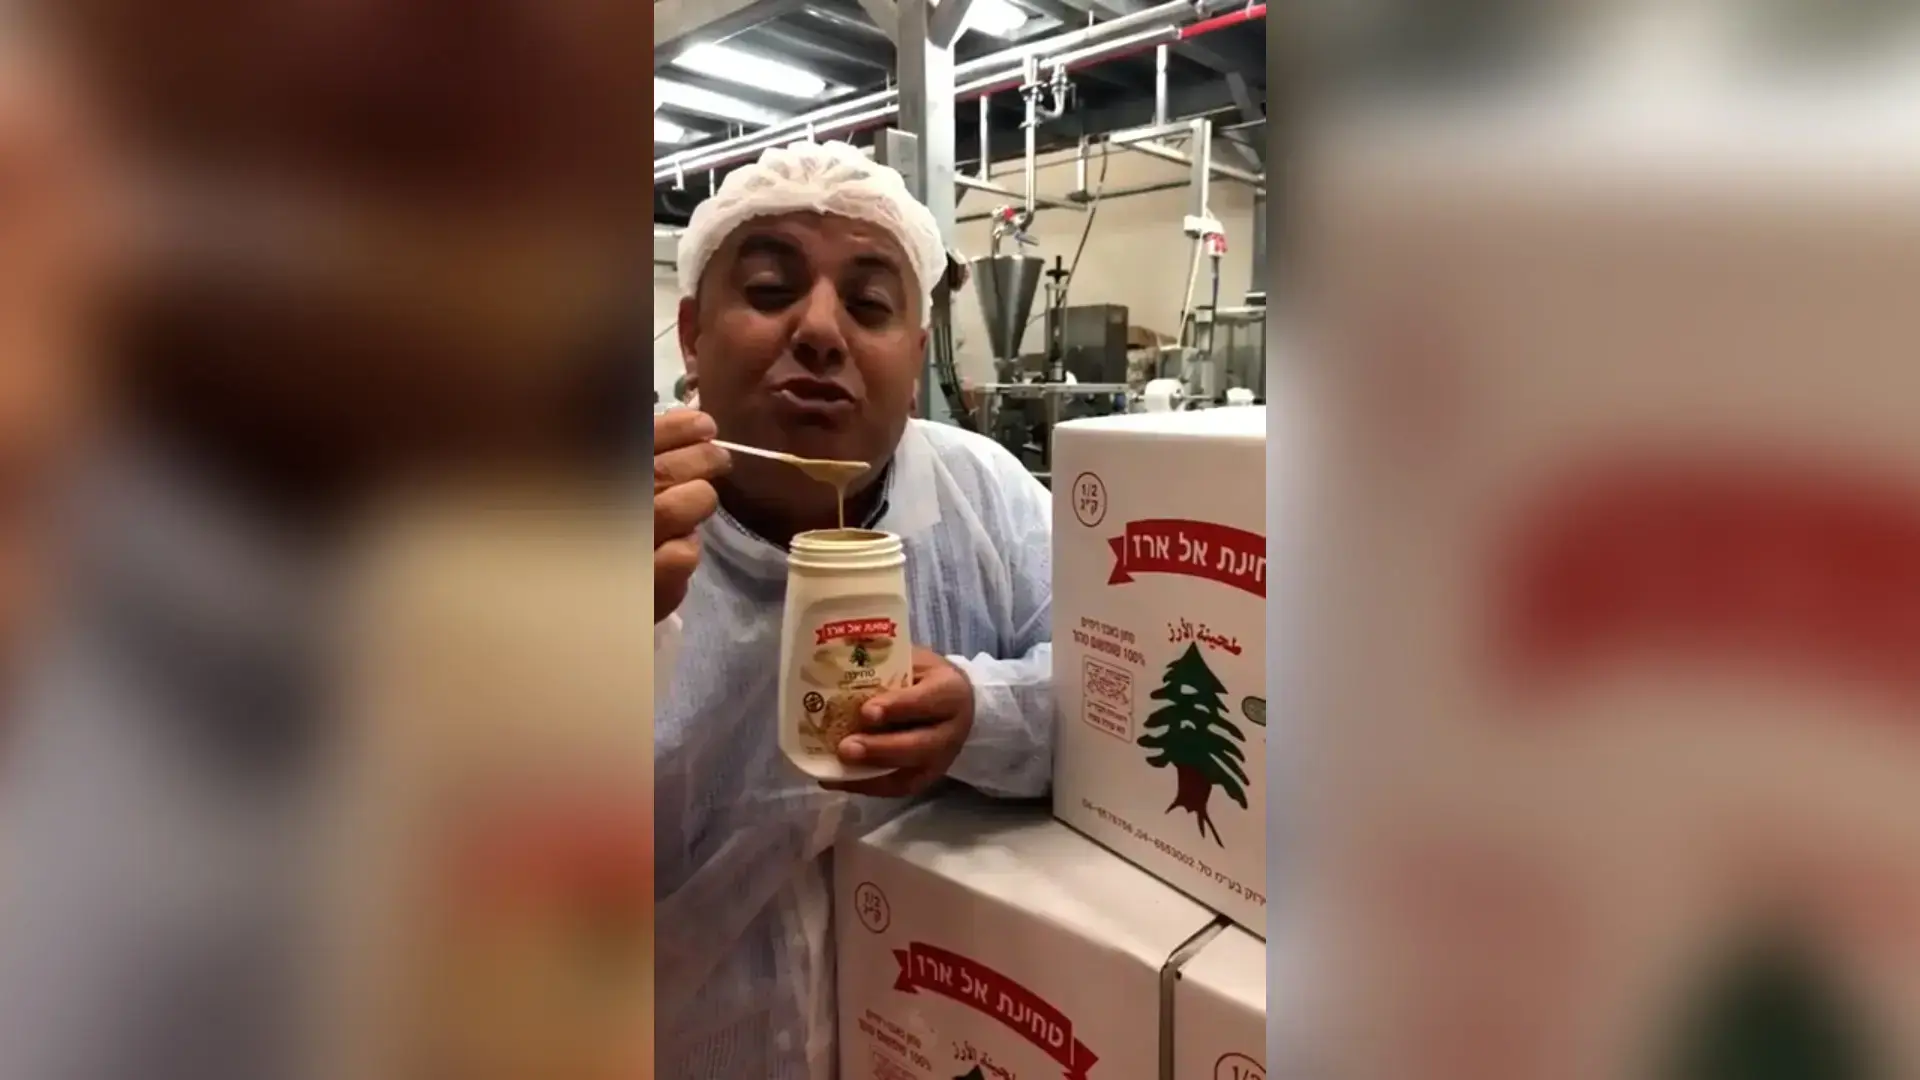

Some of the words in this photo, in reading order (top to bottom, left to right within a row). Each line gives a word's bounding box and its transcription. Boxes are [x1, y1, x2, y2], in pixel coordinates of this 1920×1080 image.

[1081, 484, 1098, 497] 1/2
[1132, 534, 1170, 560] ארז
[1179, 531, 1208, 566] אל
[1216, 546, 1266, 582] חינת
[916, 954, 954, 986] ארז
[960, 967, 990, 1005] אל
[996, 993, 1064, 1048] טחינת
